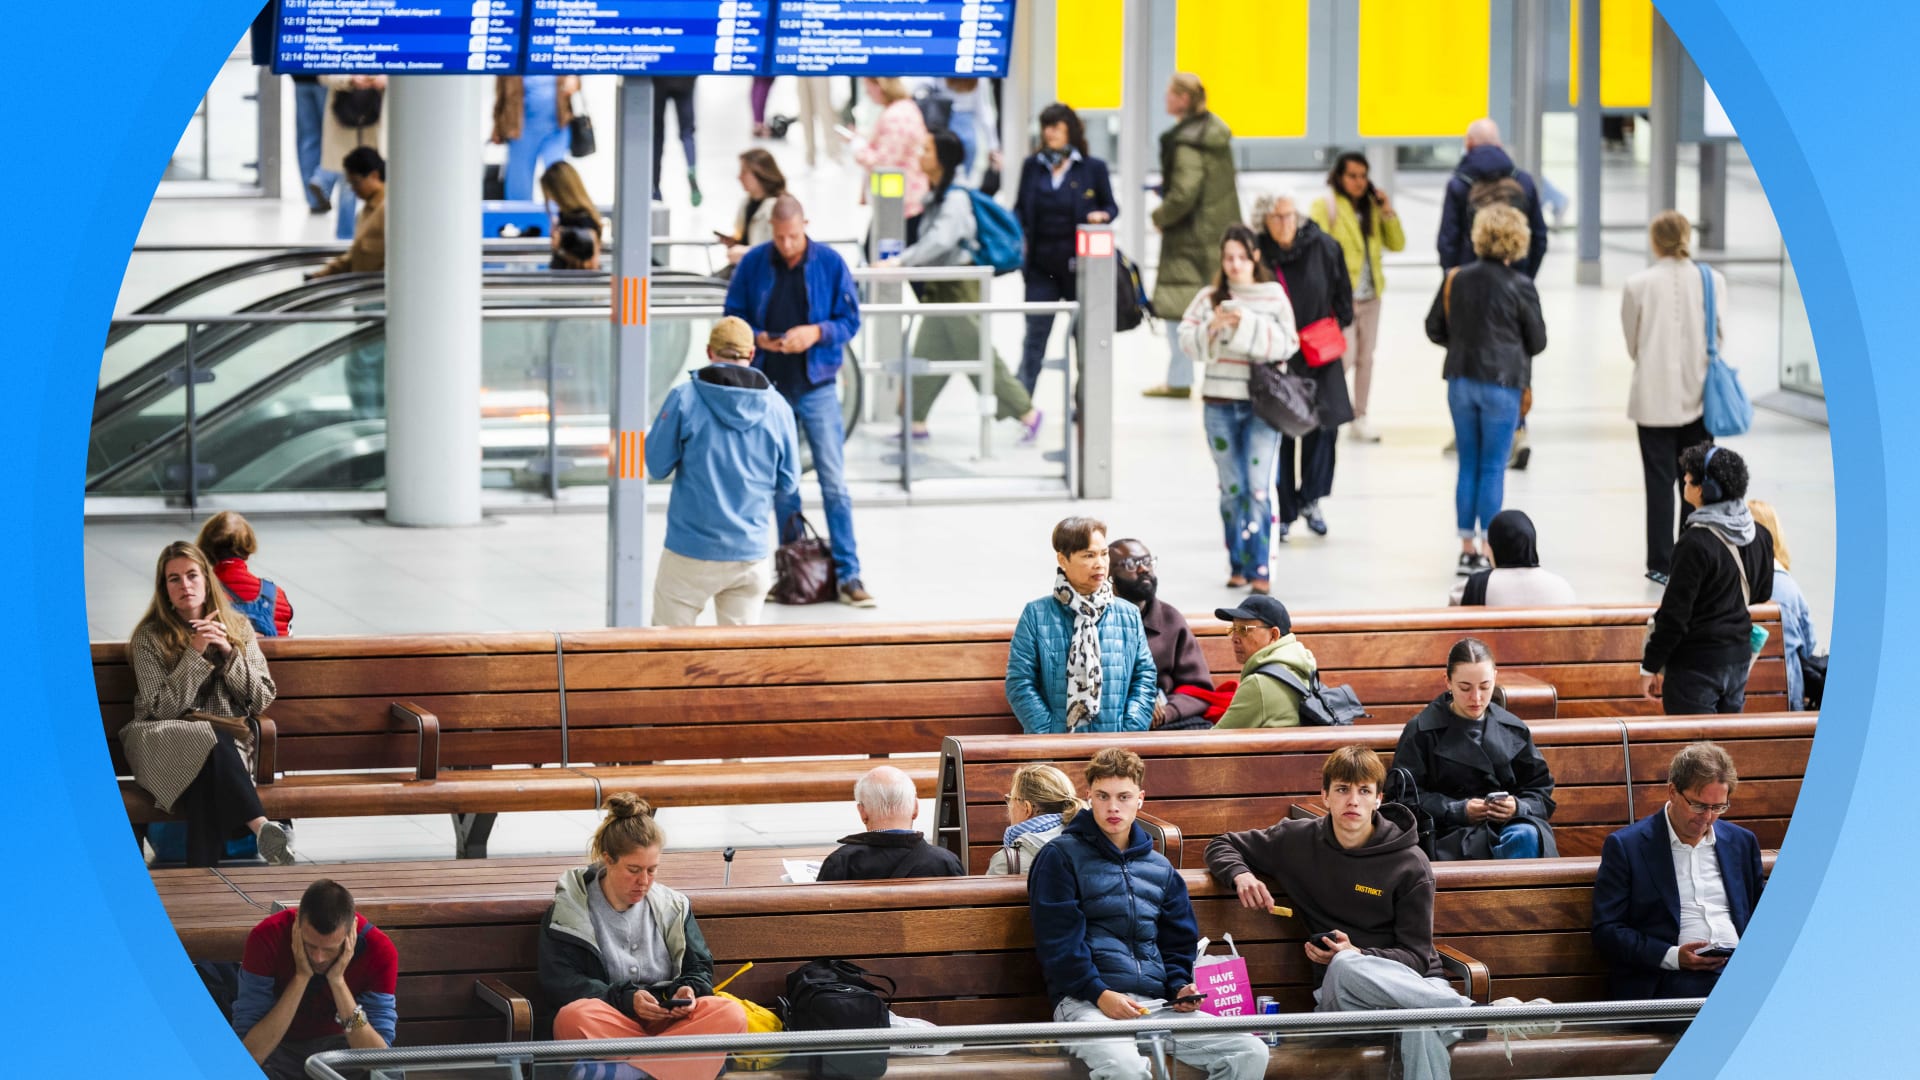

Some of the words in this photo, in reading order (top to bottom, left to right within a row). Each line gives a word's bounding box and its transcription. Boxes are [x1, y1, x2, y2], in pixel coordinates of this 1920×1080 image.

[306, 16, 323, 26] Den
[324, 17, 344, 28] Haag
[345, 16, 380, 26] Centraal
[303, 52, 320, 62] Den
[320, 52, 342, 63] Haag
[342, 52, 376, 62] Centraal
[1209, 971, 1234, 984] HAVE
[1216, 982, 1236, 995] YOU
[1214, 994, 1243, 1008] EATEN
[1218, 1007, 1242, 1016] YET?
